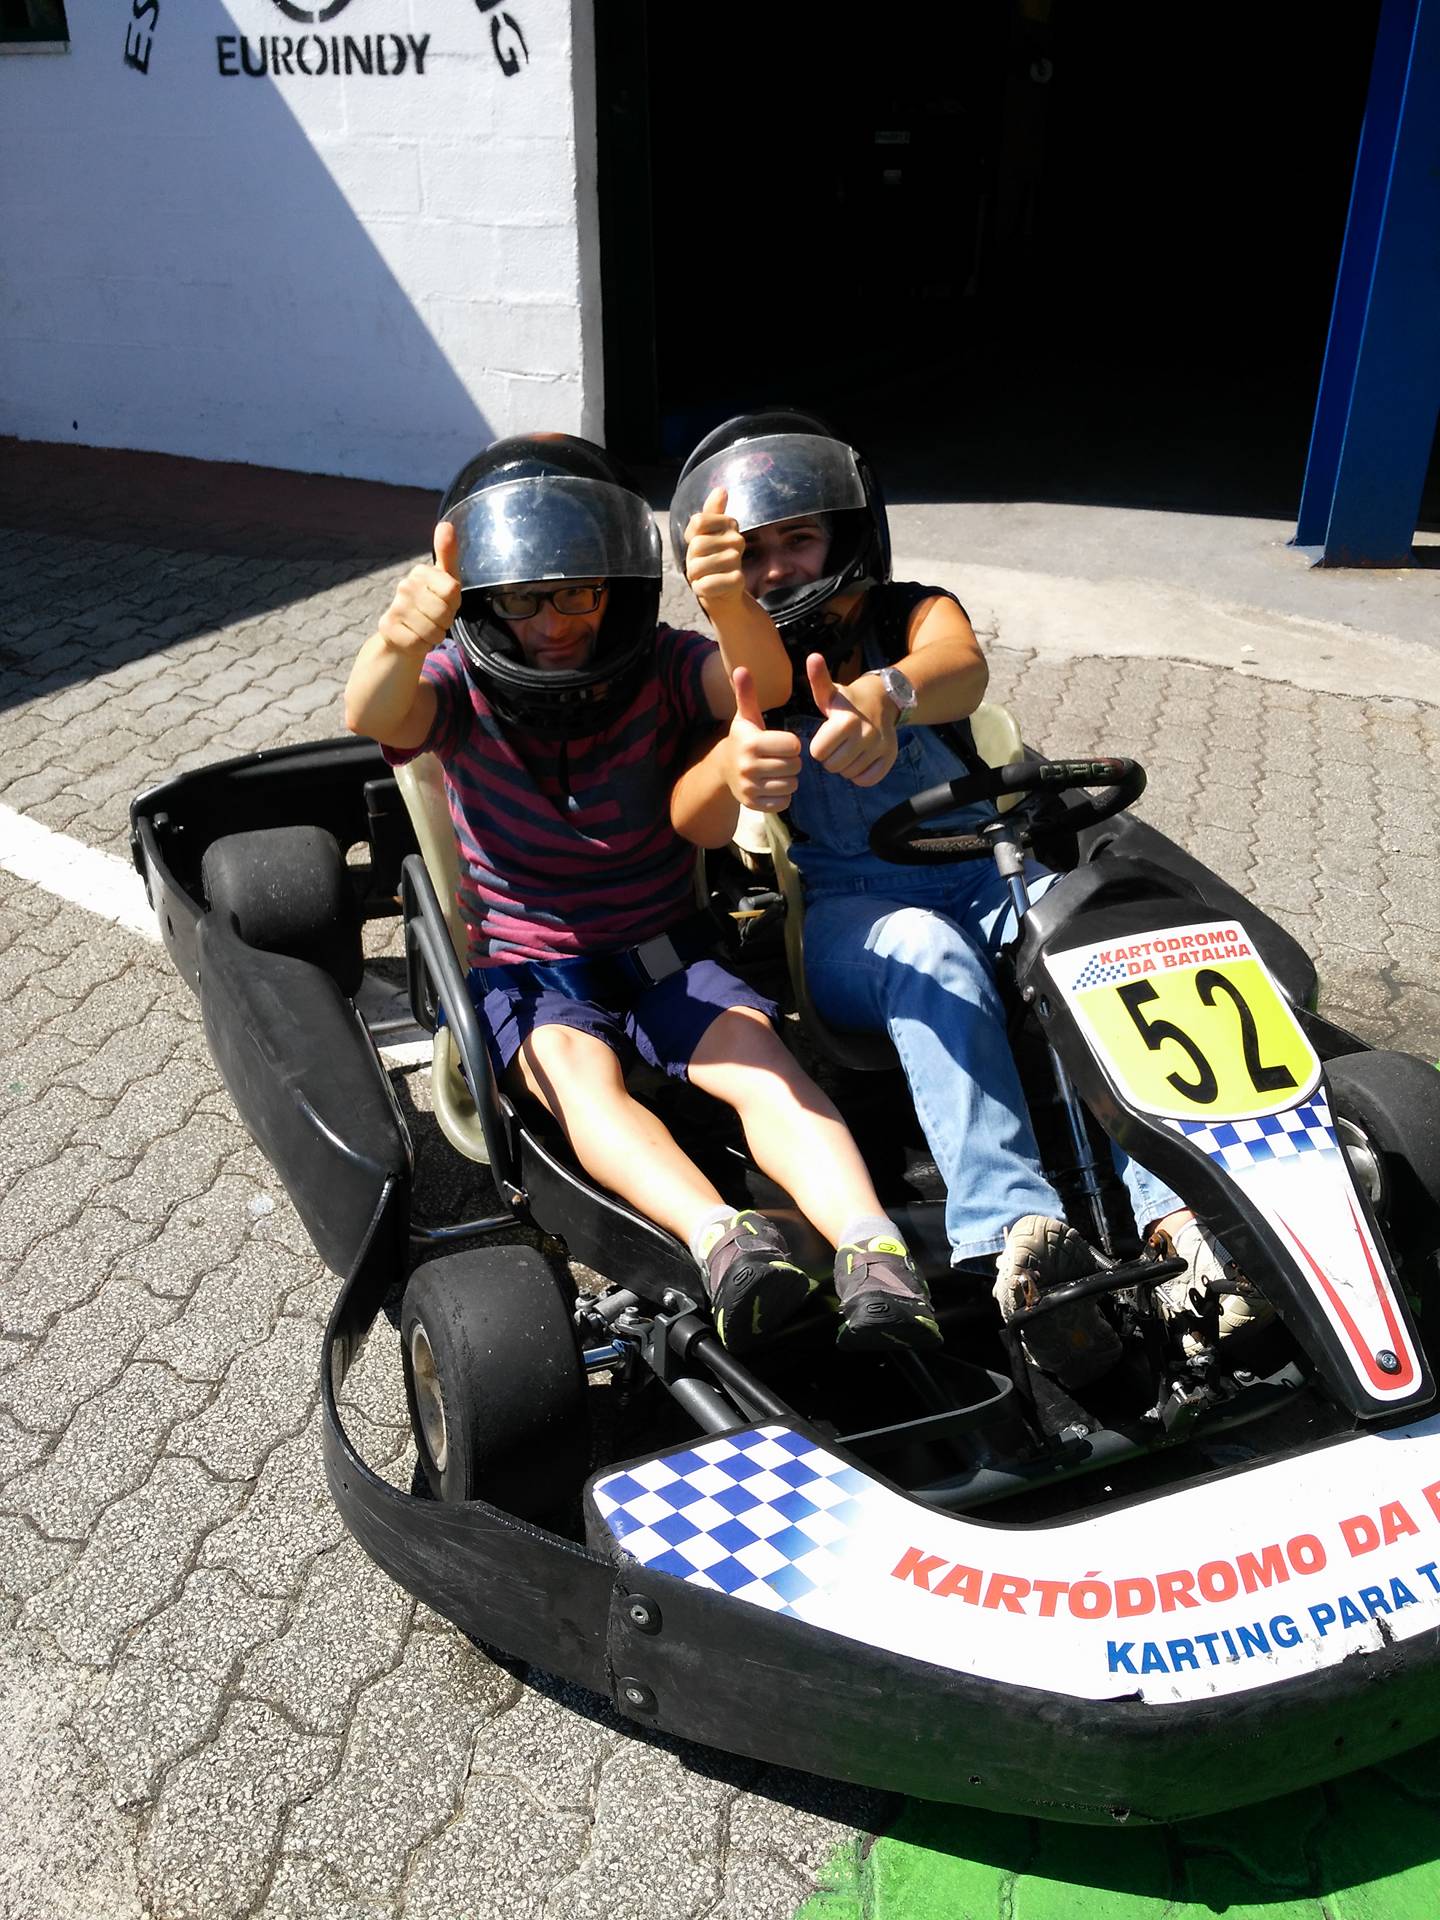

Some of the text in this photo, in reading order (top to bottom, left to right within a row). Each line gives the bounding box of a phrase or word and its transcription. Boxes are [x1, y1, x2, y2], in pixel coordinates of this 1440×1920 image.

[217, 33, 430, 77] EUROINDY
[1127, 943, 1251, 976] DA BATALHA
[1116, 969, 1299, 1104] 52
[891, 1533, 1327, 1620] KARTÓDROMO
[1338, 1500, 1421, 1558] DA
[1108, 1614, 1303, 1675] KARTING
[1310, 1575, 1420, 1638] PARA
